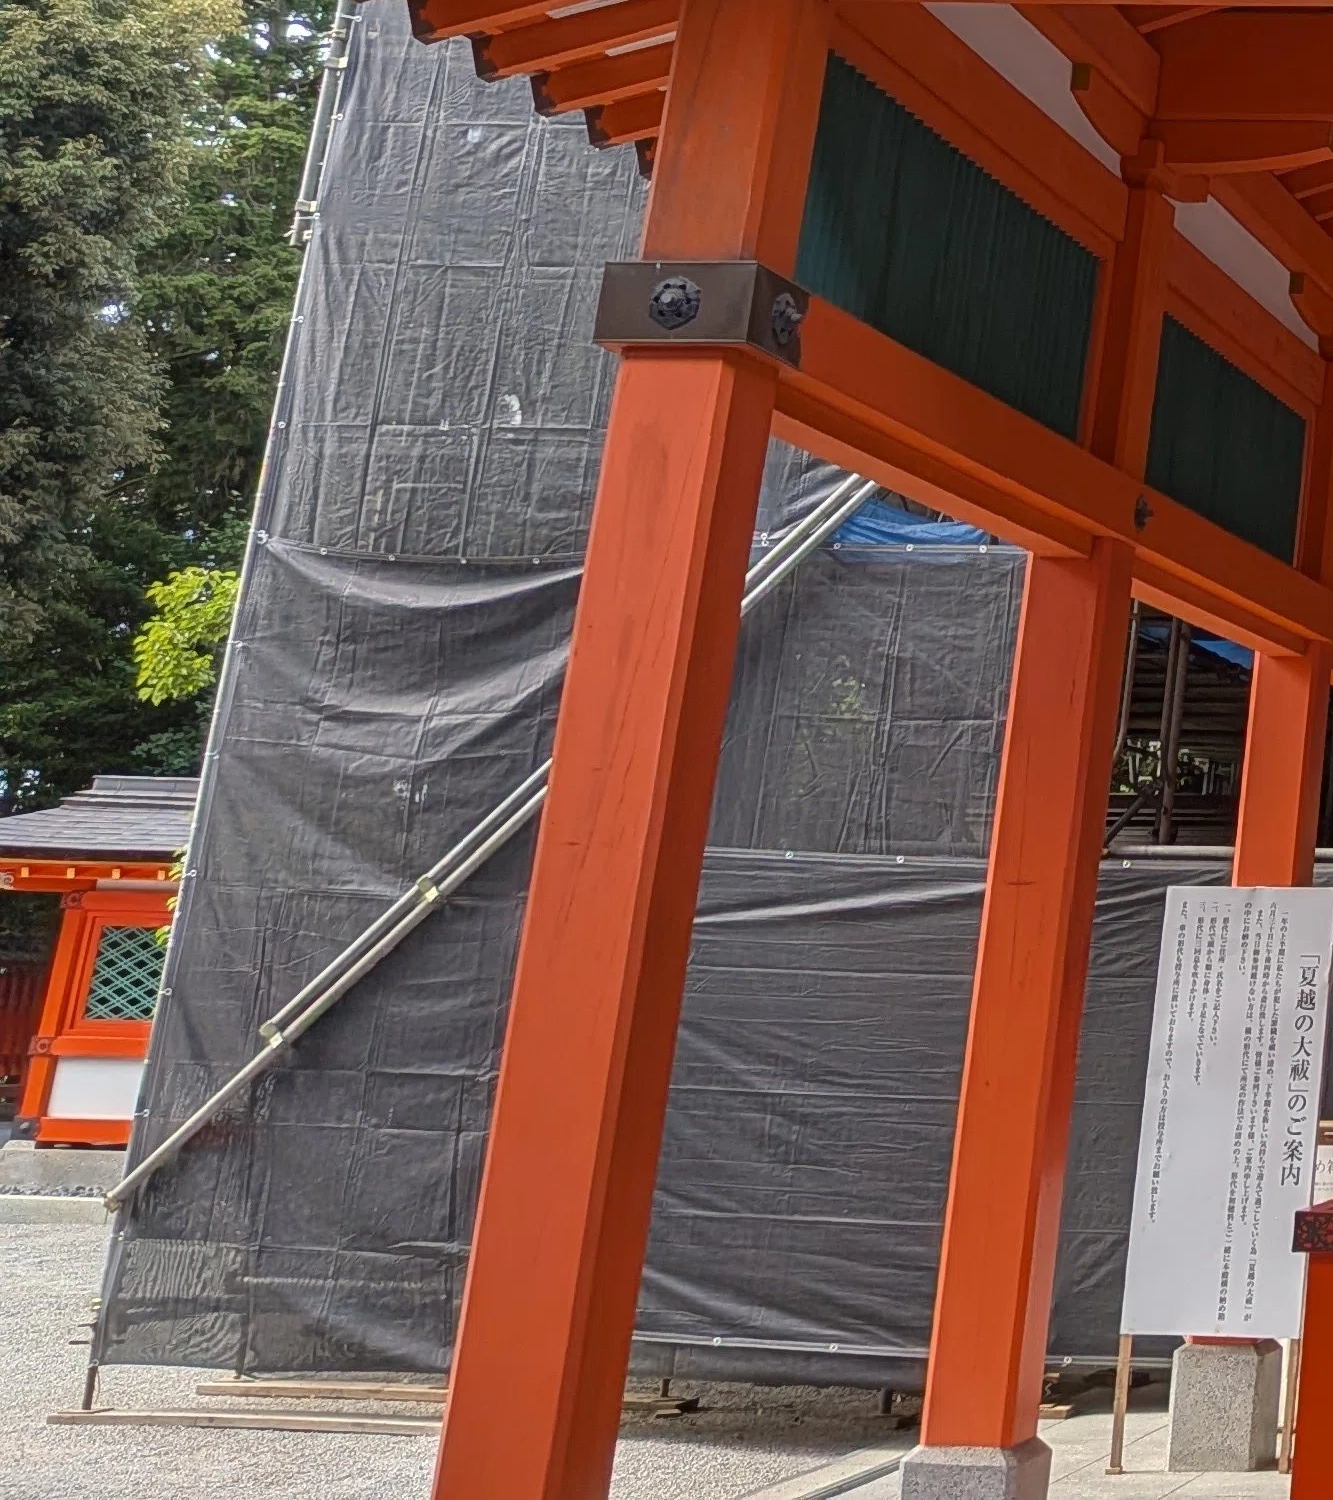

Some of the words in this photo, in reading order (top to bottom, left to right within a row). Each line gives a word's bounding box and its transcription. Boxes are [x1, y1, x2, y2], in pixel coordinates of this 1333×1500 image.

[1280, 954, 1321, 1187] 「夏越の大祓」のご案内
